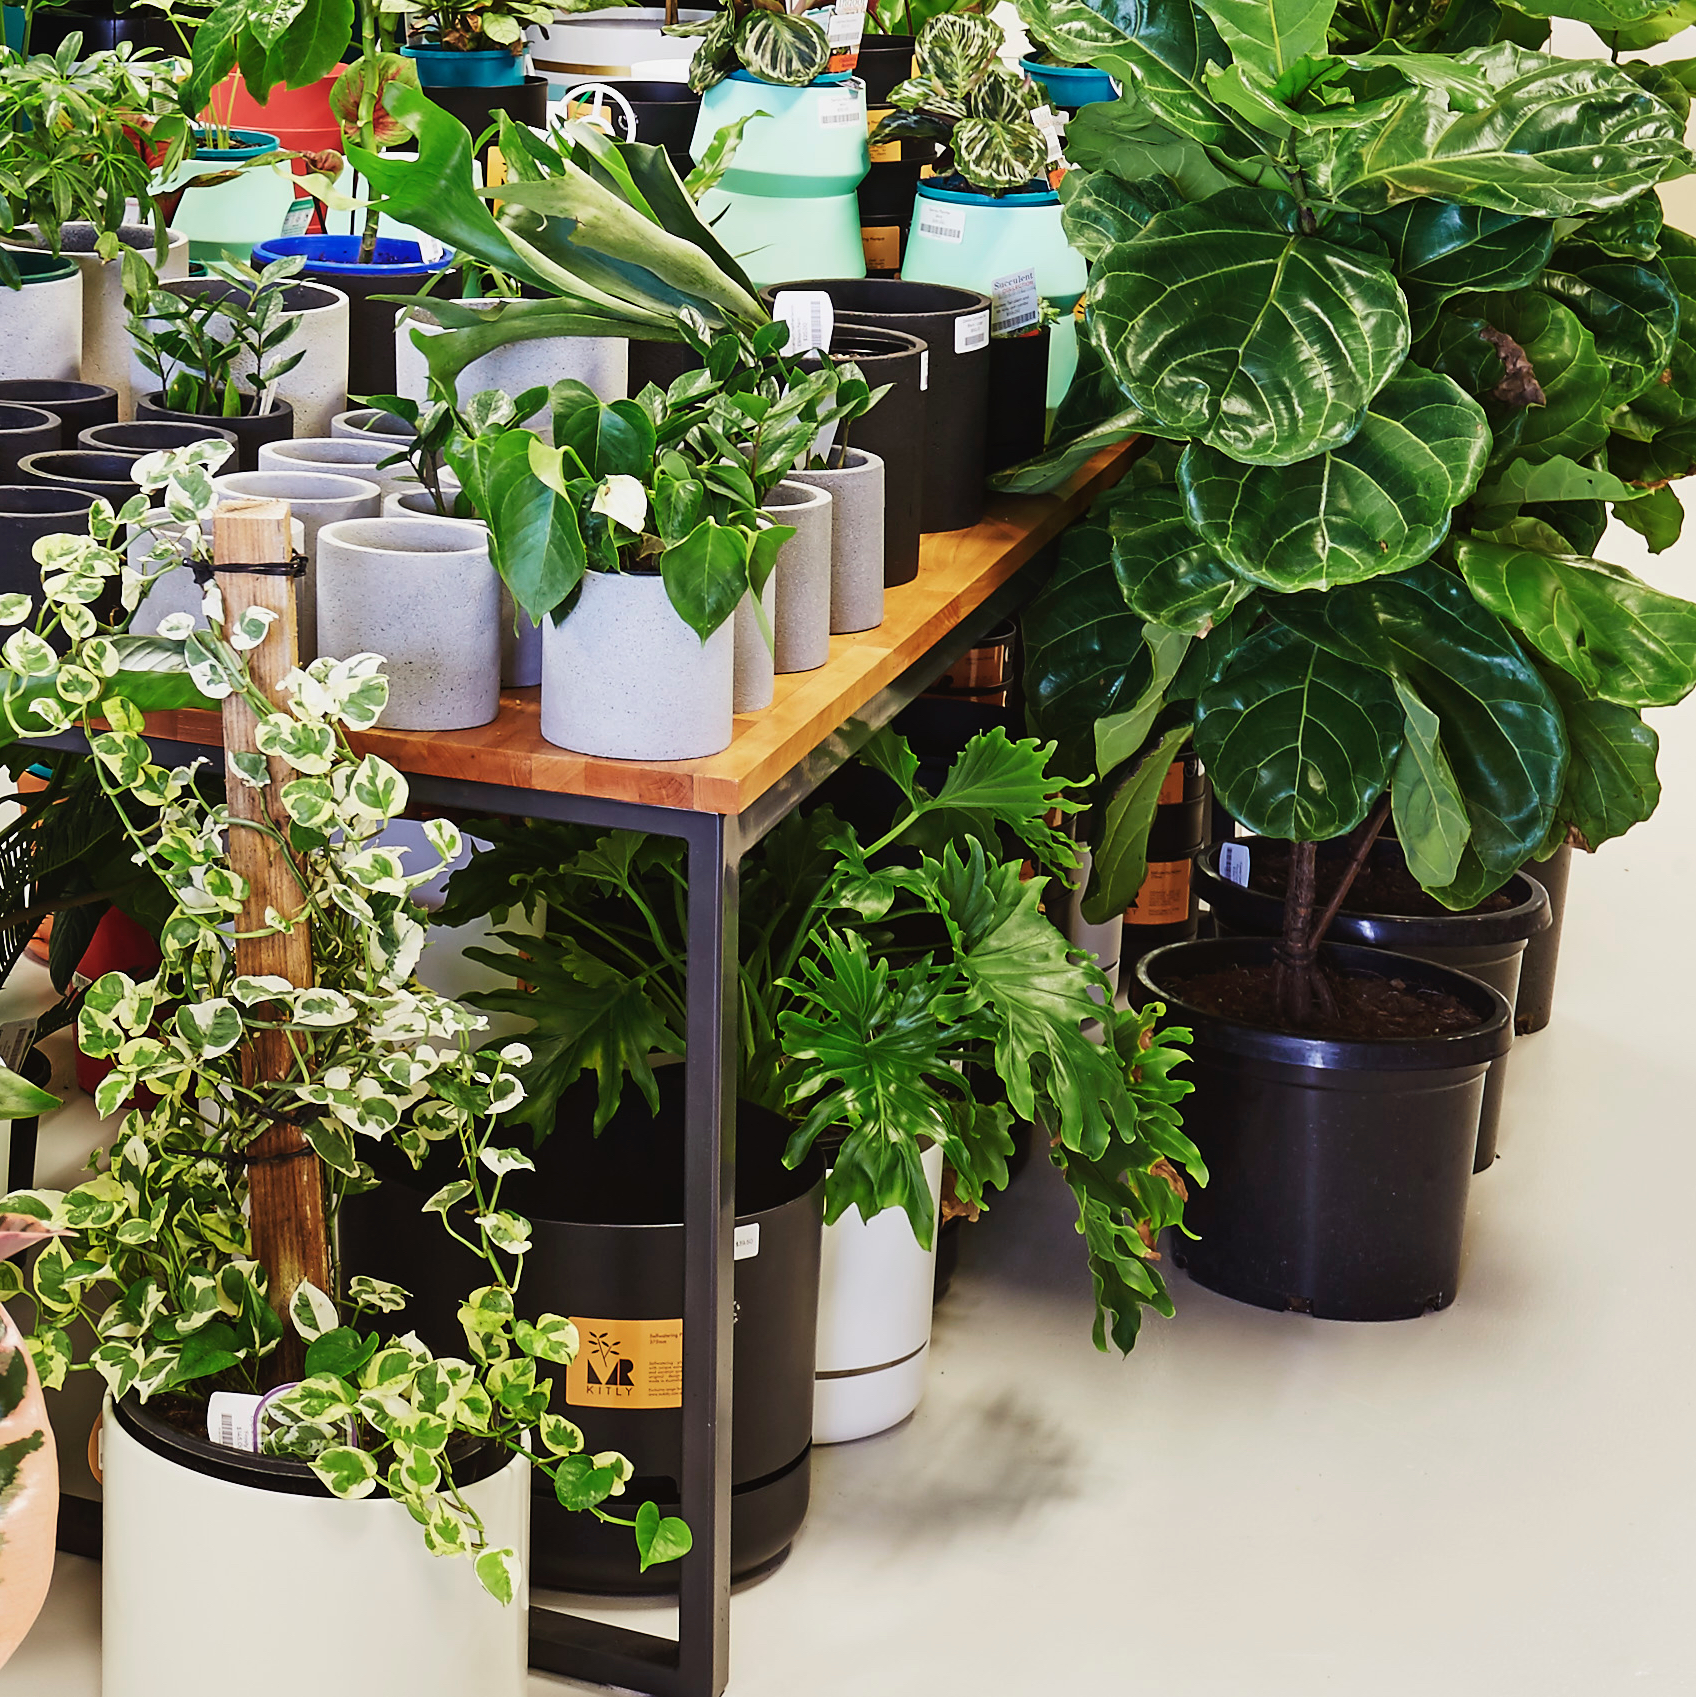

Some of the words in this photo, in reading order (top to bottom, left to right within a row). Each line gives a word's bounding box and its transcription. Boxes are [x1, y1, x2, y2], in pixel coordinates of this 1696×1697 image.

[994, 272, 1034, 290] Succulent
[587, 1358, 635, 1387] MR
[586, 1385, 633, 1396] KITLY
